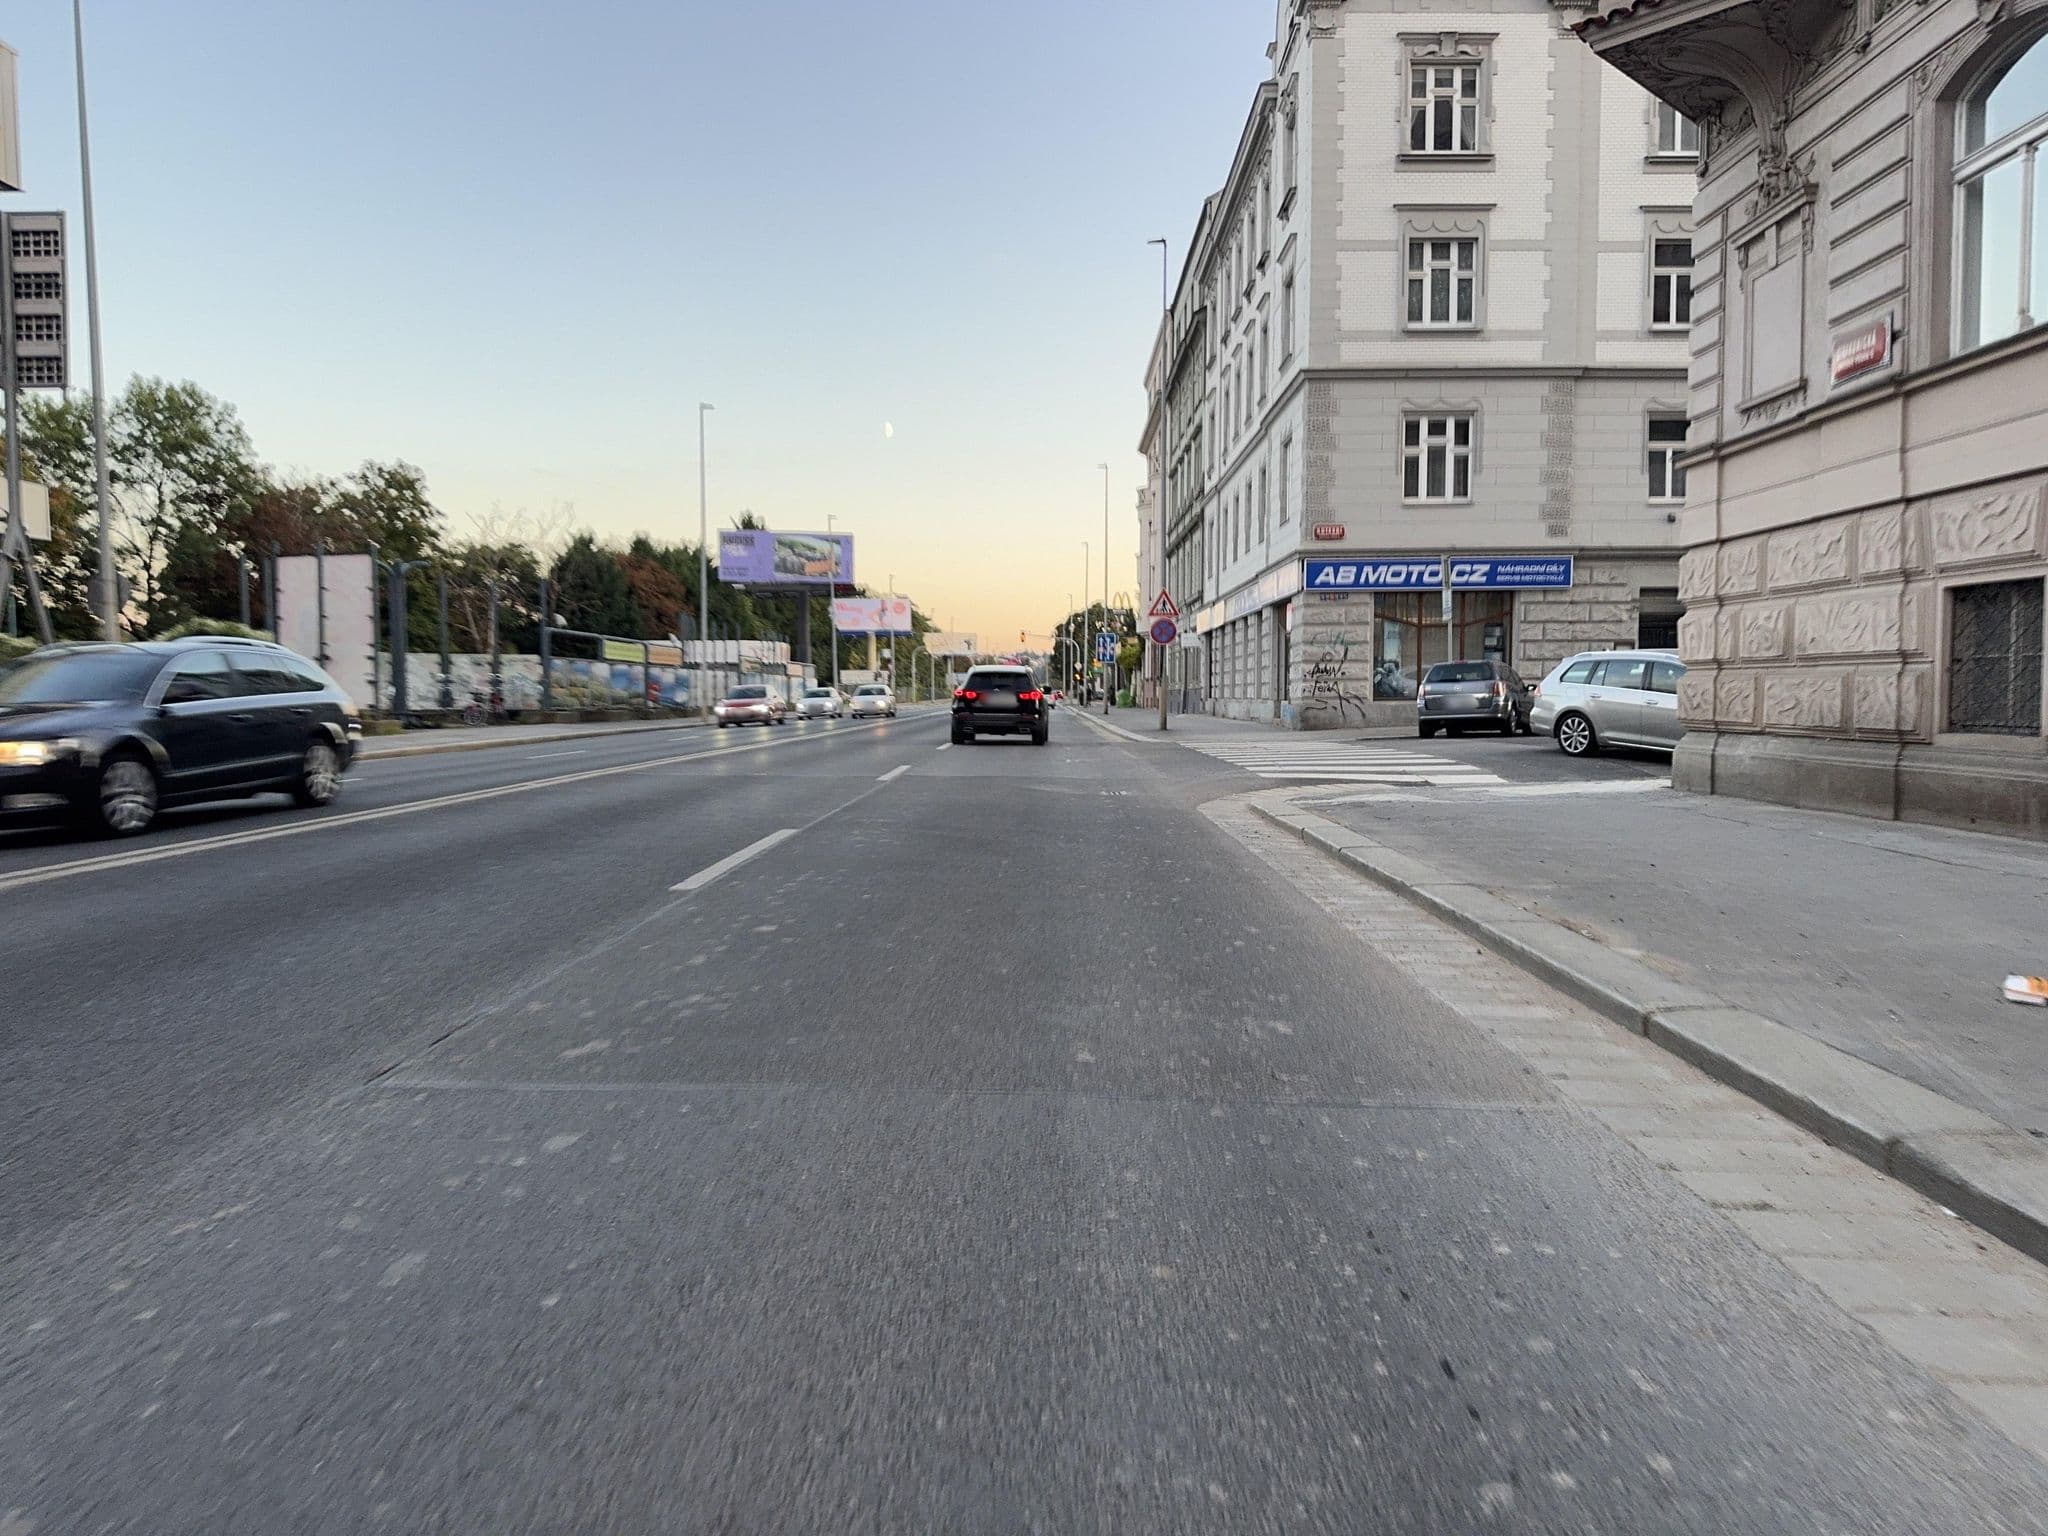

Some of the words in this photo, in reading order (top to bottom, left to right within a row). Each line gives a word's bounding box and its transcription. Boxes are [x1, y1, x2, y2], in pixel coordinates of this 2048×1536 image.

[1314, 565, 1357, 586] AB
[1359, 564, 1443, 585] MOTO
[1451, 563, 1491, 584] CZ
